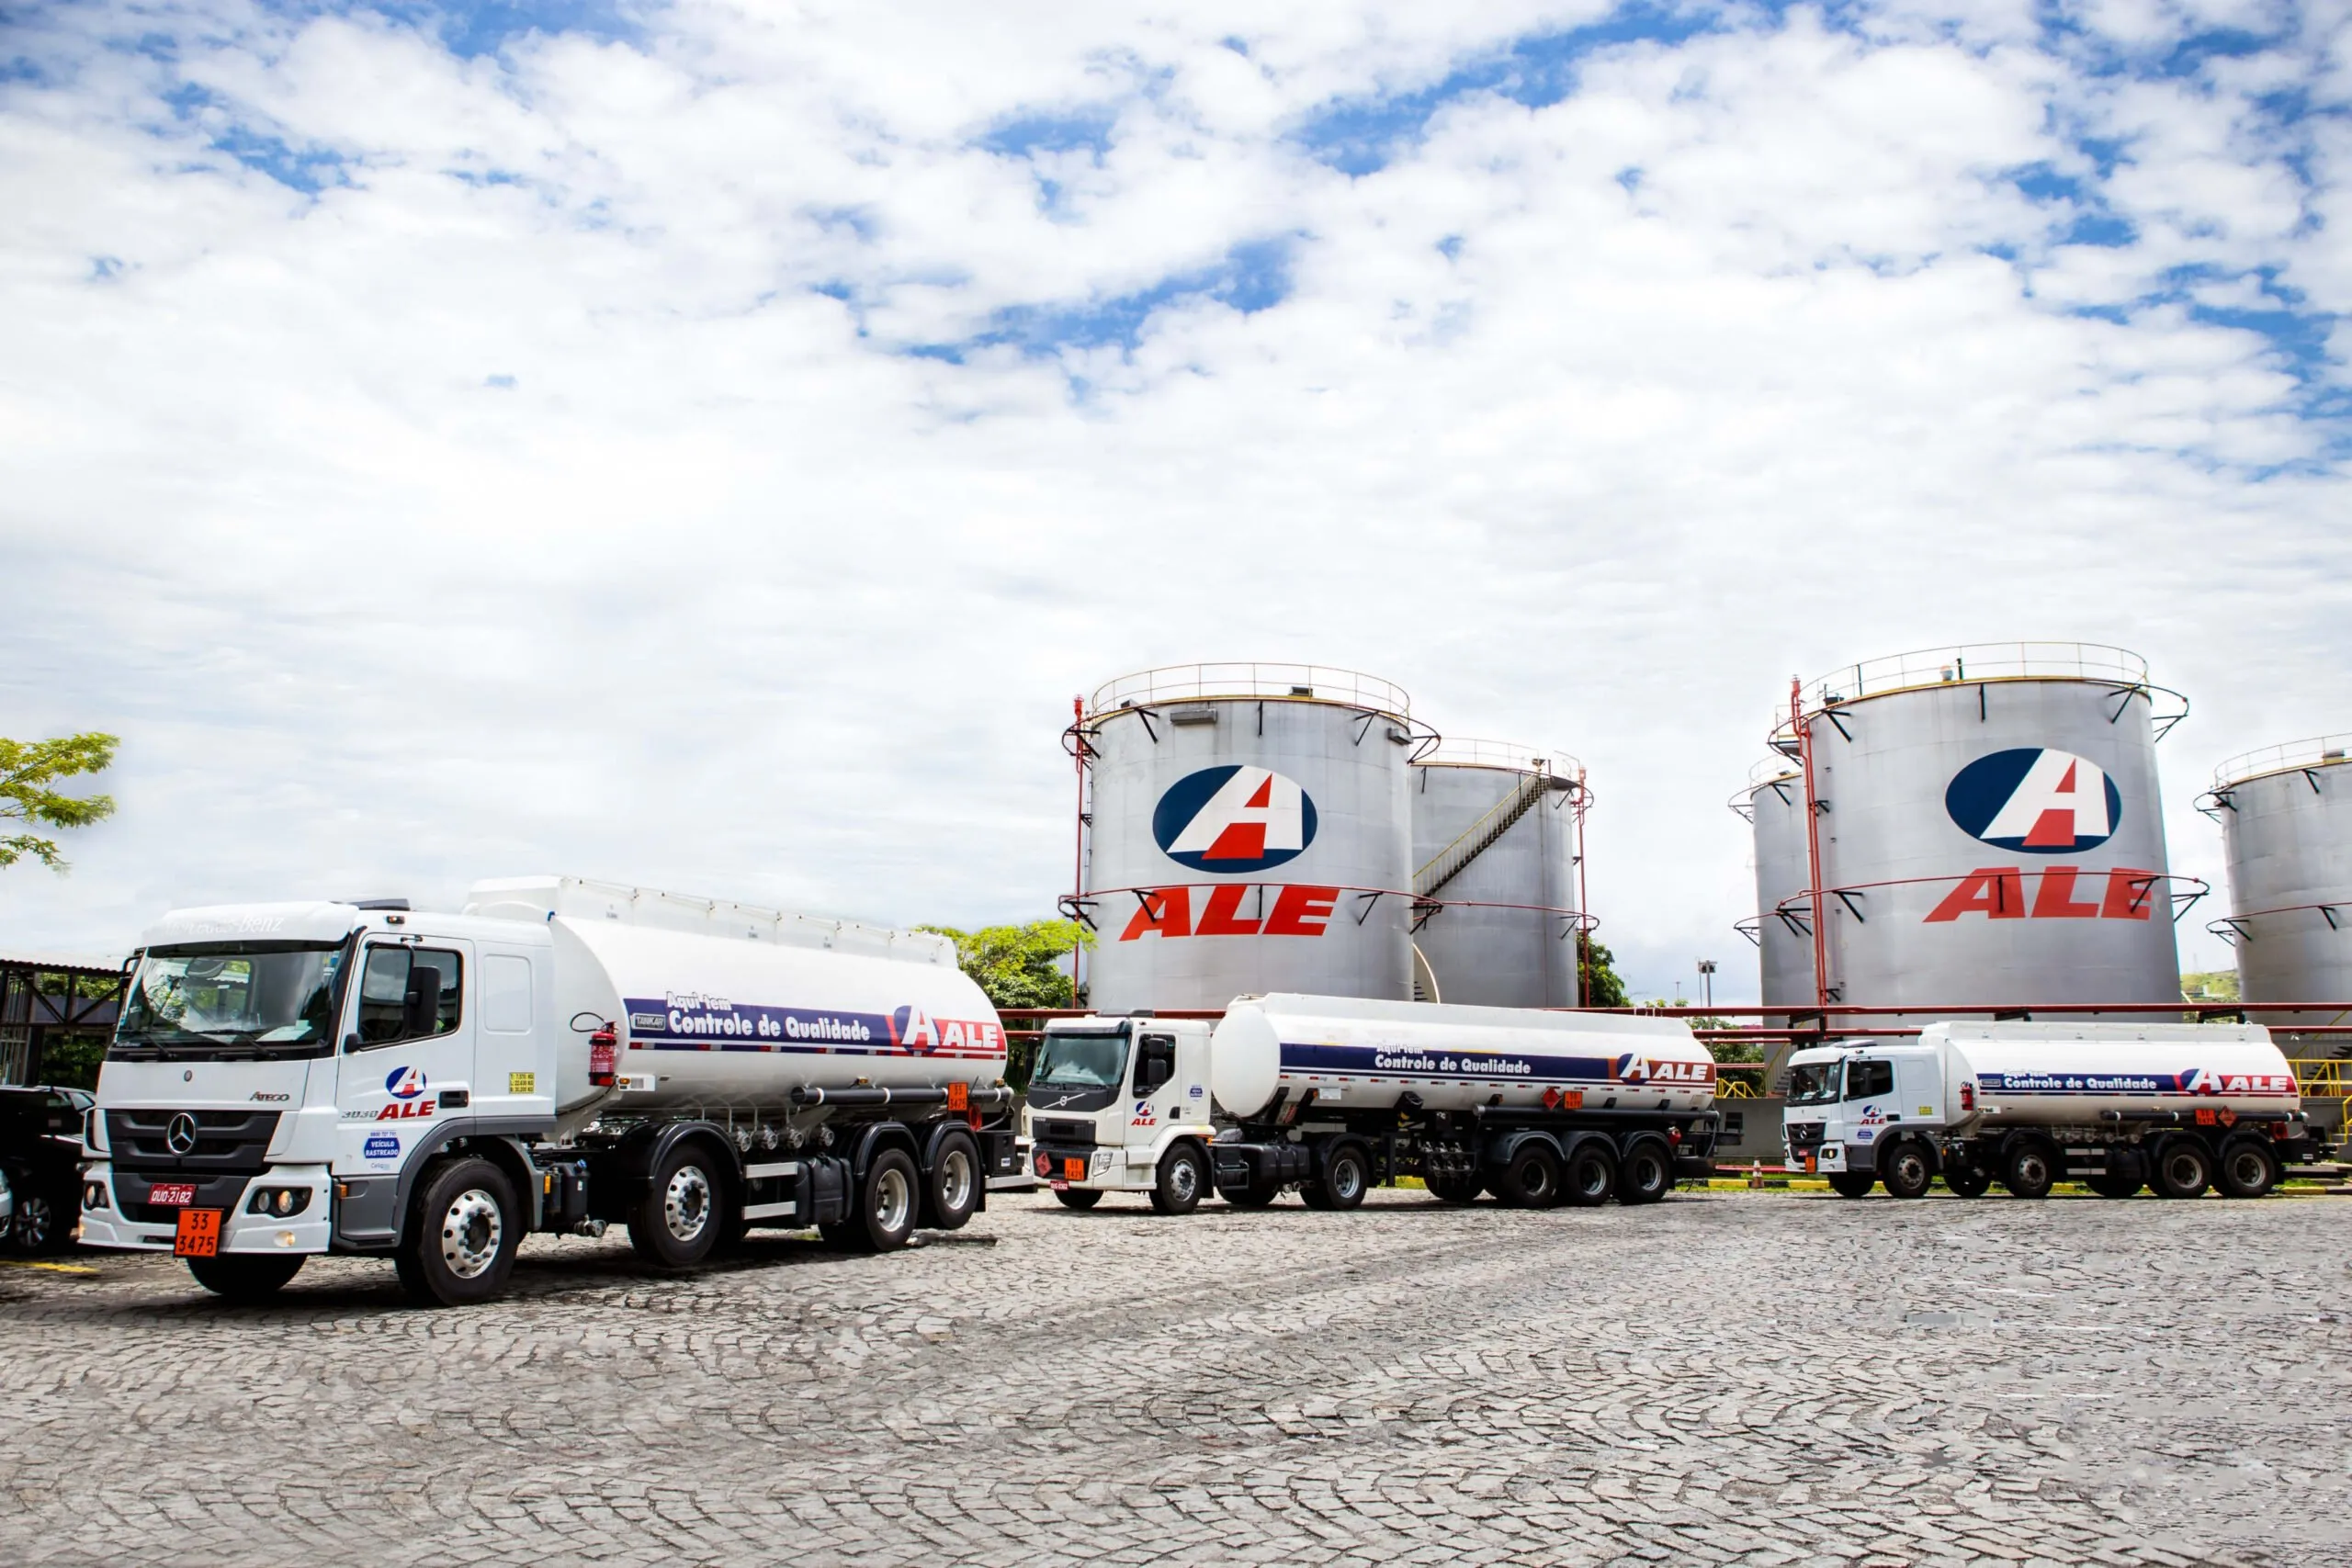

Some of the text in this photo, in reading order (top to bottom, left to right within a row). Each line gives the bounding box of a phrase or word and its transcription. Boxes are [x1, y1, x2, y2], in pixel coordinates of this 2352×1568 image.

[1979, 748, 2110, 840] A
[1166, 765, 1303, 853] A
[1922, 866, 2153, 923] ALE
[1119, 885, 1340, 942] ALE
[666, 990, 732, 1012] Aqui tem
[669, 1010, 870, 1041] Controle de Qualidade
[942, 1022, 998, 1048] ALE
[1376, 1043, 1424, 1055] Aqui tem
[1375, 1055, 1531, 1074] Controle de Qualidade
[1653, 1064, 1708, 1080] ALE
[2004, 1077, 2061, 1089] Controle
[2065, 1077, 2083, 1089] de
[2086, 1077, 2157, 1089] Qualidade
[2225, 1077, 2288, 1090] ALE
[376, 1100, 436, 1121] ALE
[1131, 1118, 1157, 1126] ALE
[371, 1139, 395, 1147] VEÍCULO
[191, 1213, 209, 1230] 33
[178, 1235, 215, 1254] 3475
